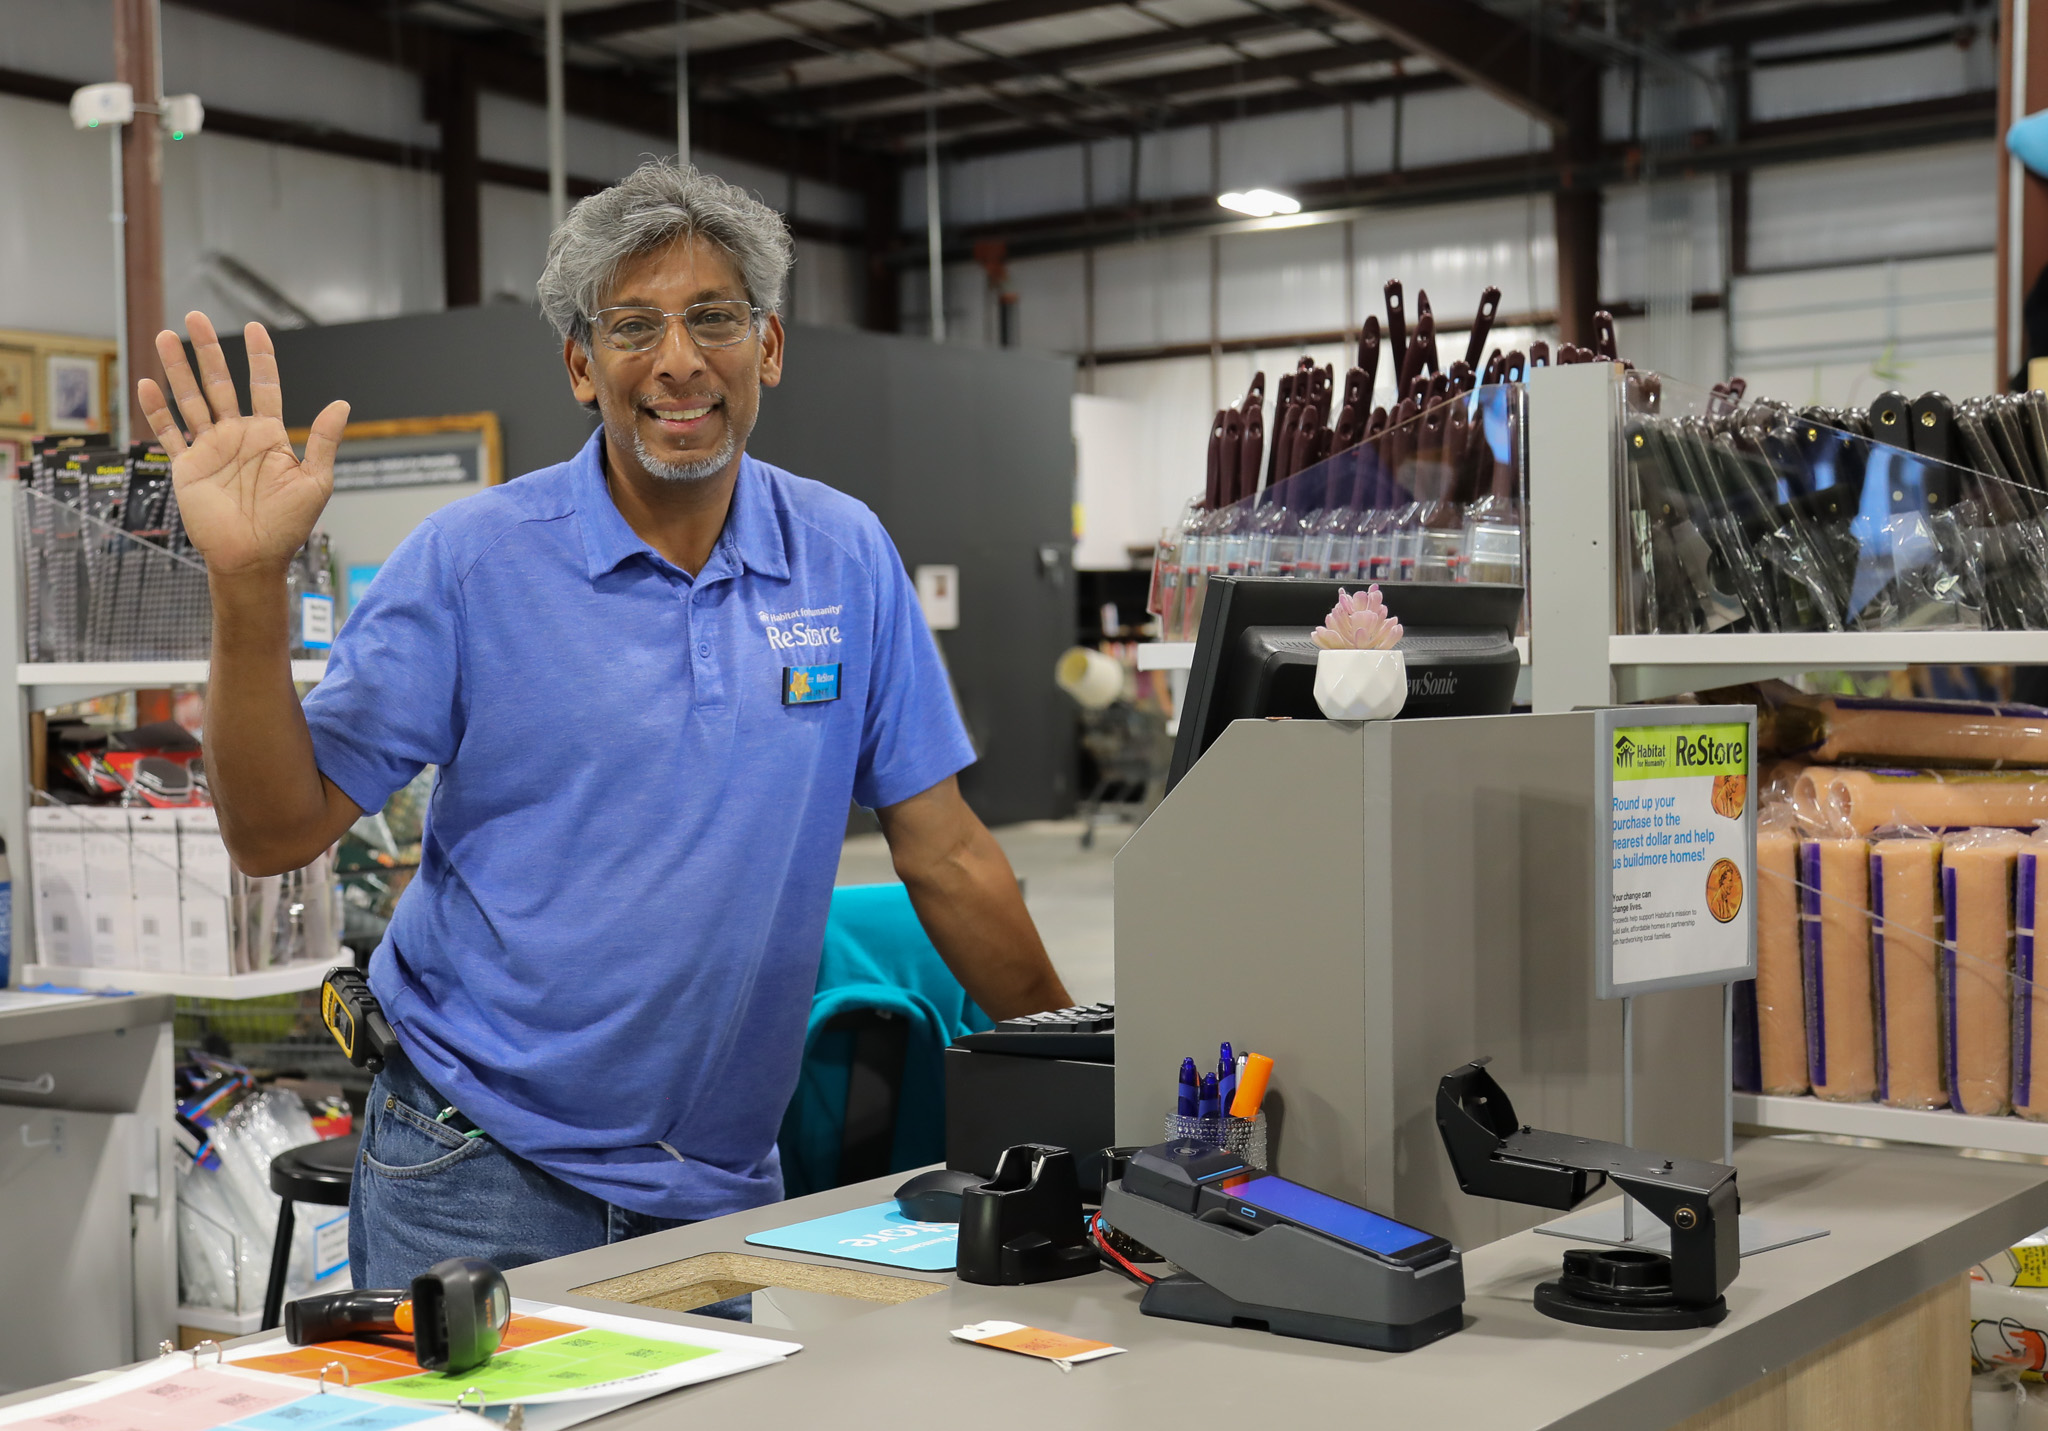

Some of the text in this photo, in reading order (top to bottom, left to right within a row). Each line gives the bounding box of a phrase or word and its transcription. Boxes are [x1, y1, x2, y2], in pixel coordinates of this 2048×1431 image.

[770, 610, 800, 622] Habitat
[766, 623, 842, 650] ReStore
[1637, 744, 1666, 758] Habitat
[1676, 734, 1743, 767] ReStore
[1644, 759, 1666, 768] Humanity
[1613, 796, 1676, 811] Round up your
[1653, 814, 1663, 827] to
[1665, 812, 1681, 827] the
[1613, 828, 1715, 850] nearest dollar and help
[1623, 852, 1667, 868] buildmore
[1670, 847, 1705, 863] homes!
[1624, 892, 1641, 900] change
[1642, 891, 1651, 899] can
[1630, 903, 1643, 911] lives.
